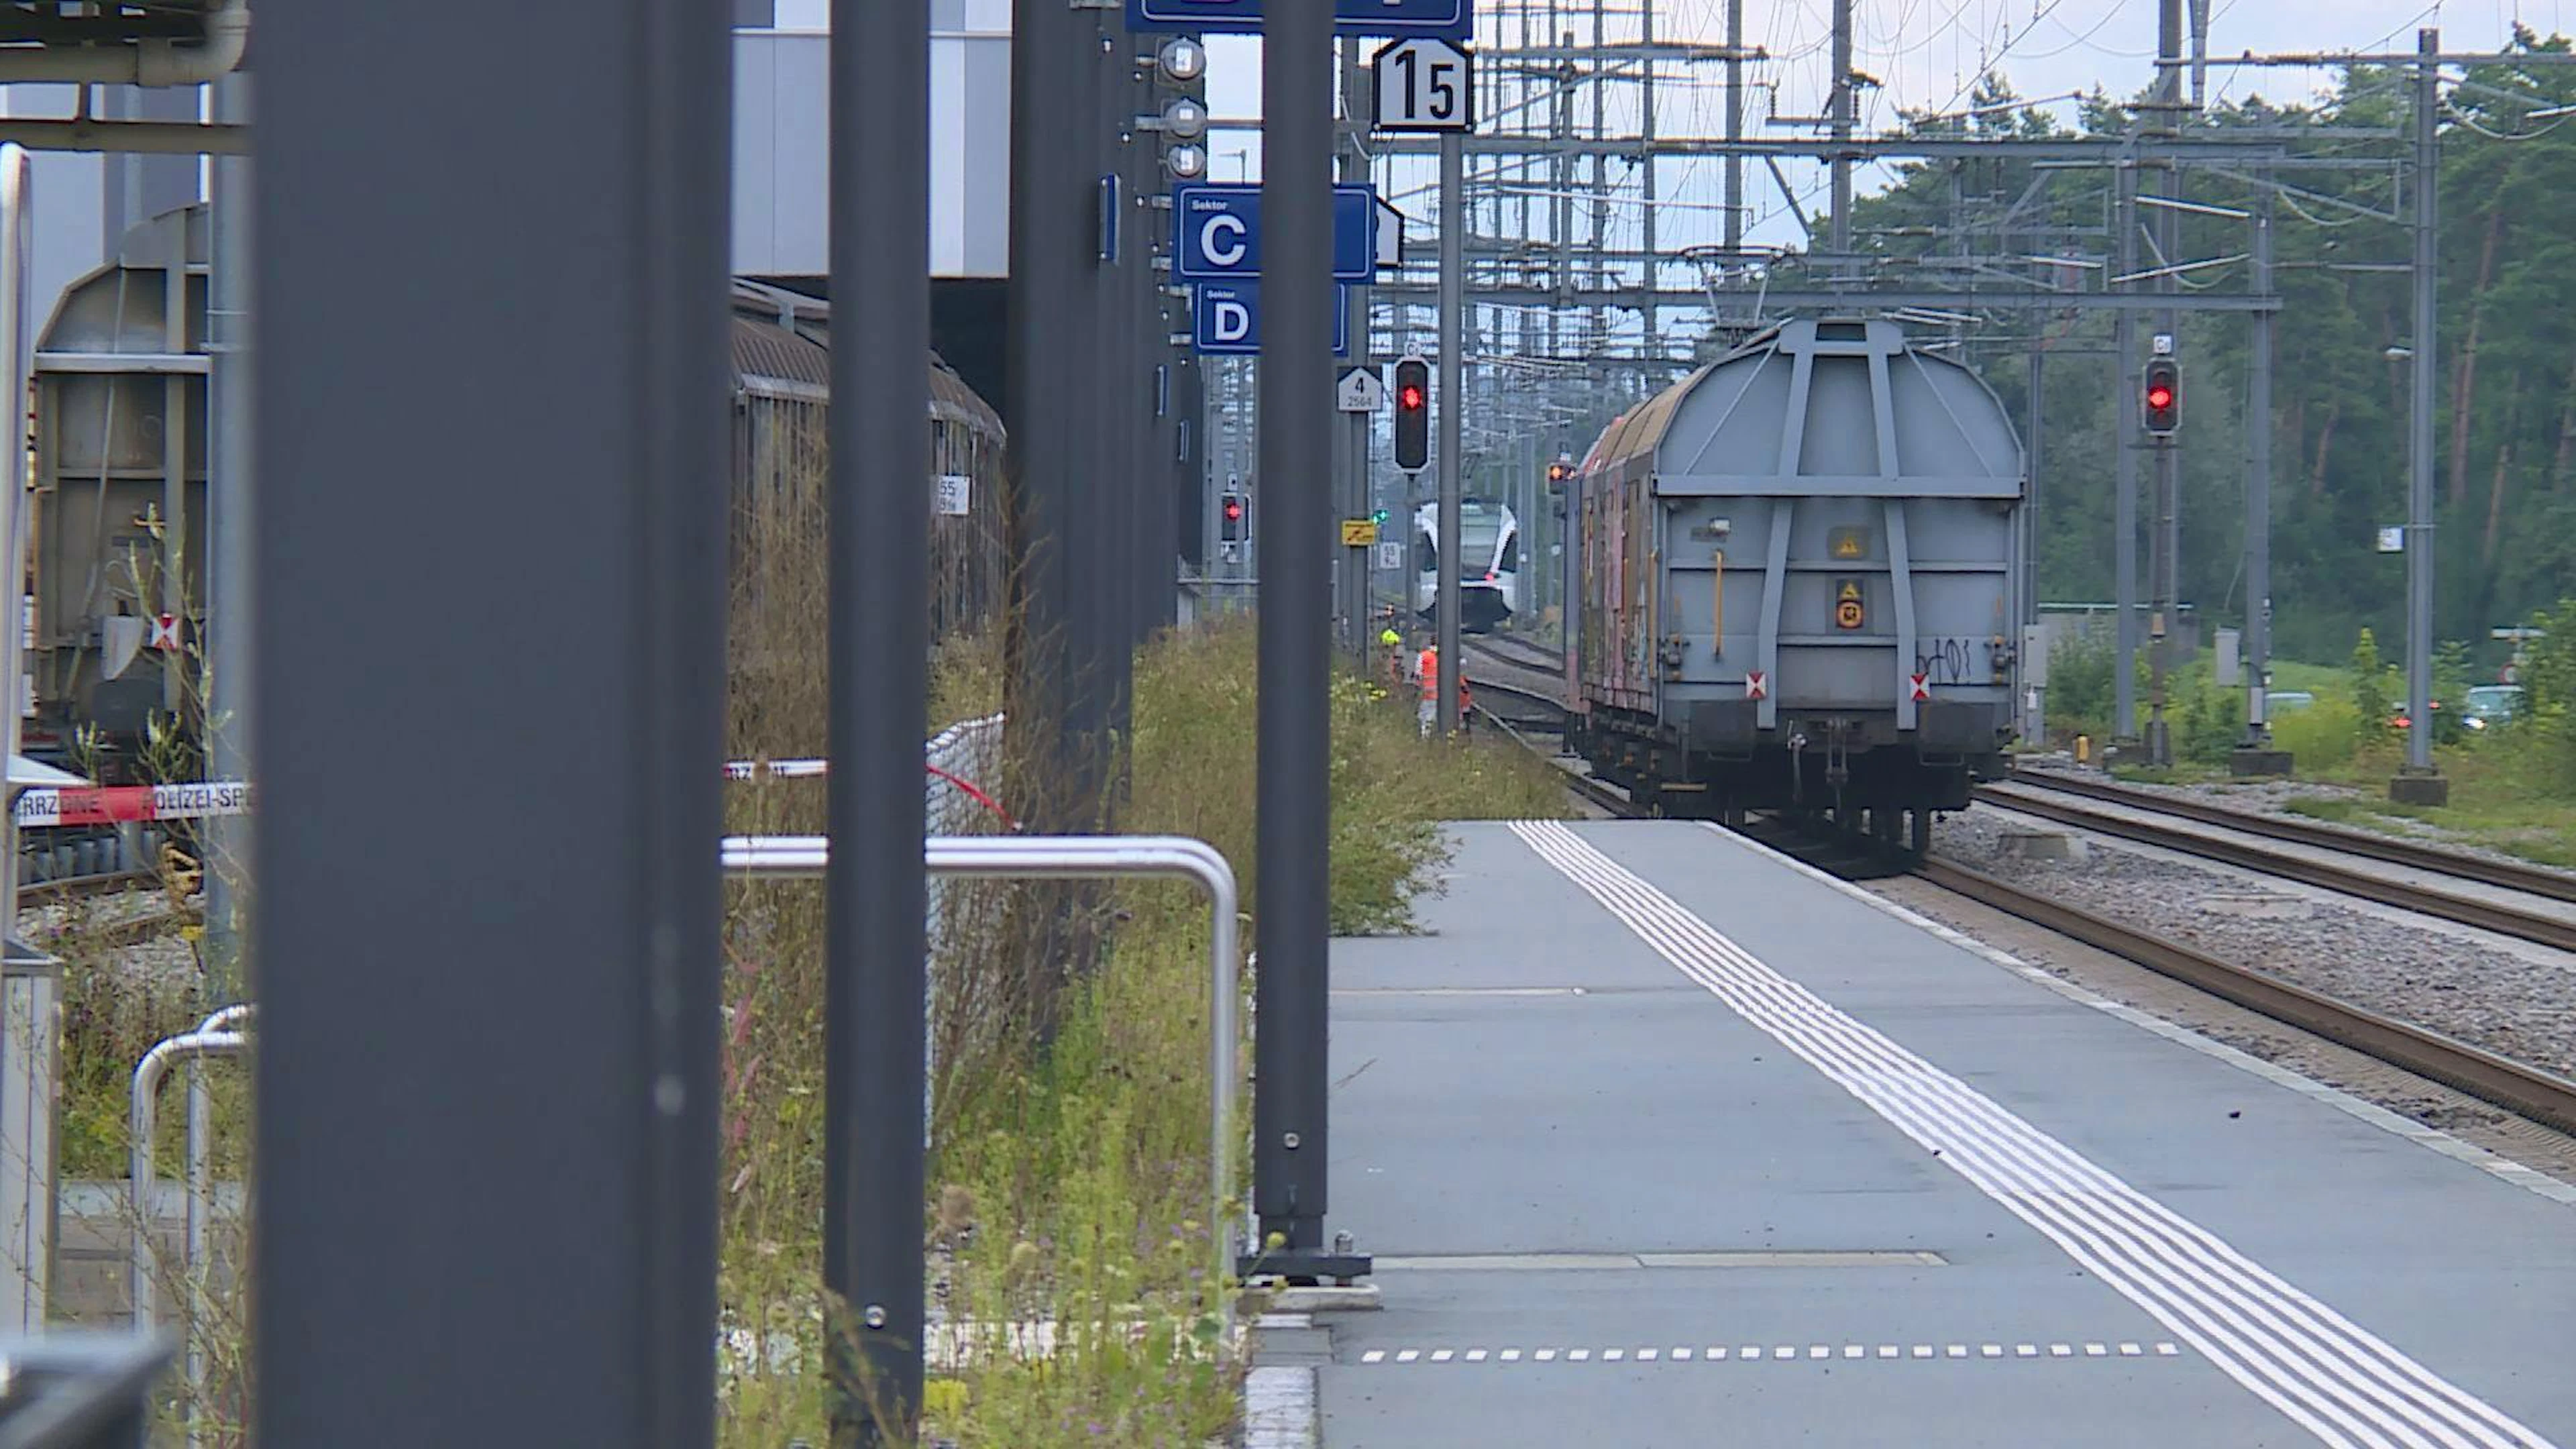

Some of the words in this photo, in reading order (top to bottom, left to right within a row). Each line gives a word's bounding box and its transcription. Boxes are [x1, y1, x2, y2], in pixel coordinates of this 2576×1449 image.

[1395, 50, 1454, 120] 15
[1191, 199, 1228, 211] Sektor
[1201, 214, 1246, 266] C
[1215, 301, 1249, 341] D
[1355, 377, 1364, 394] 4
